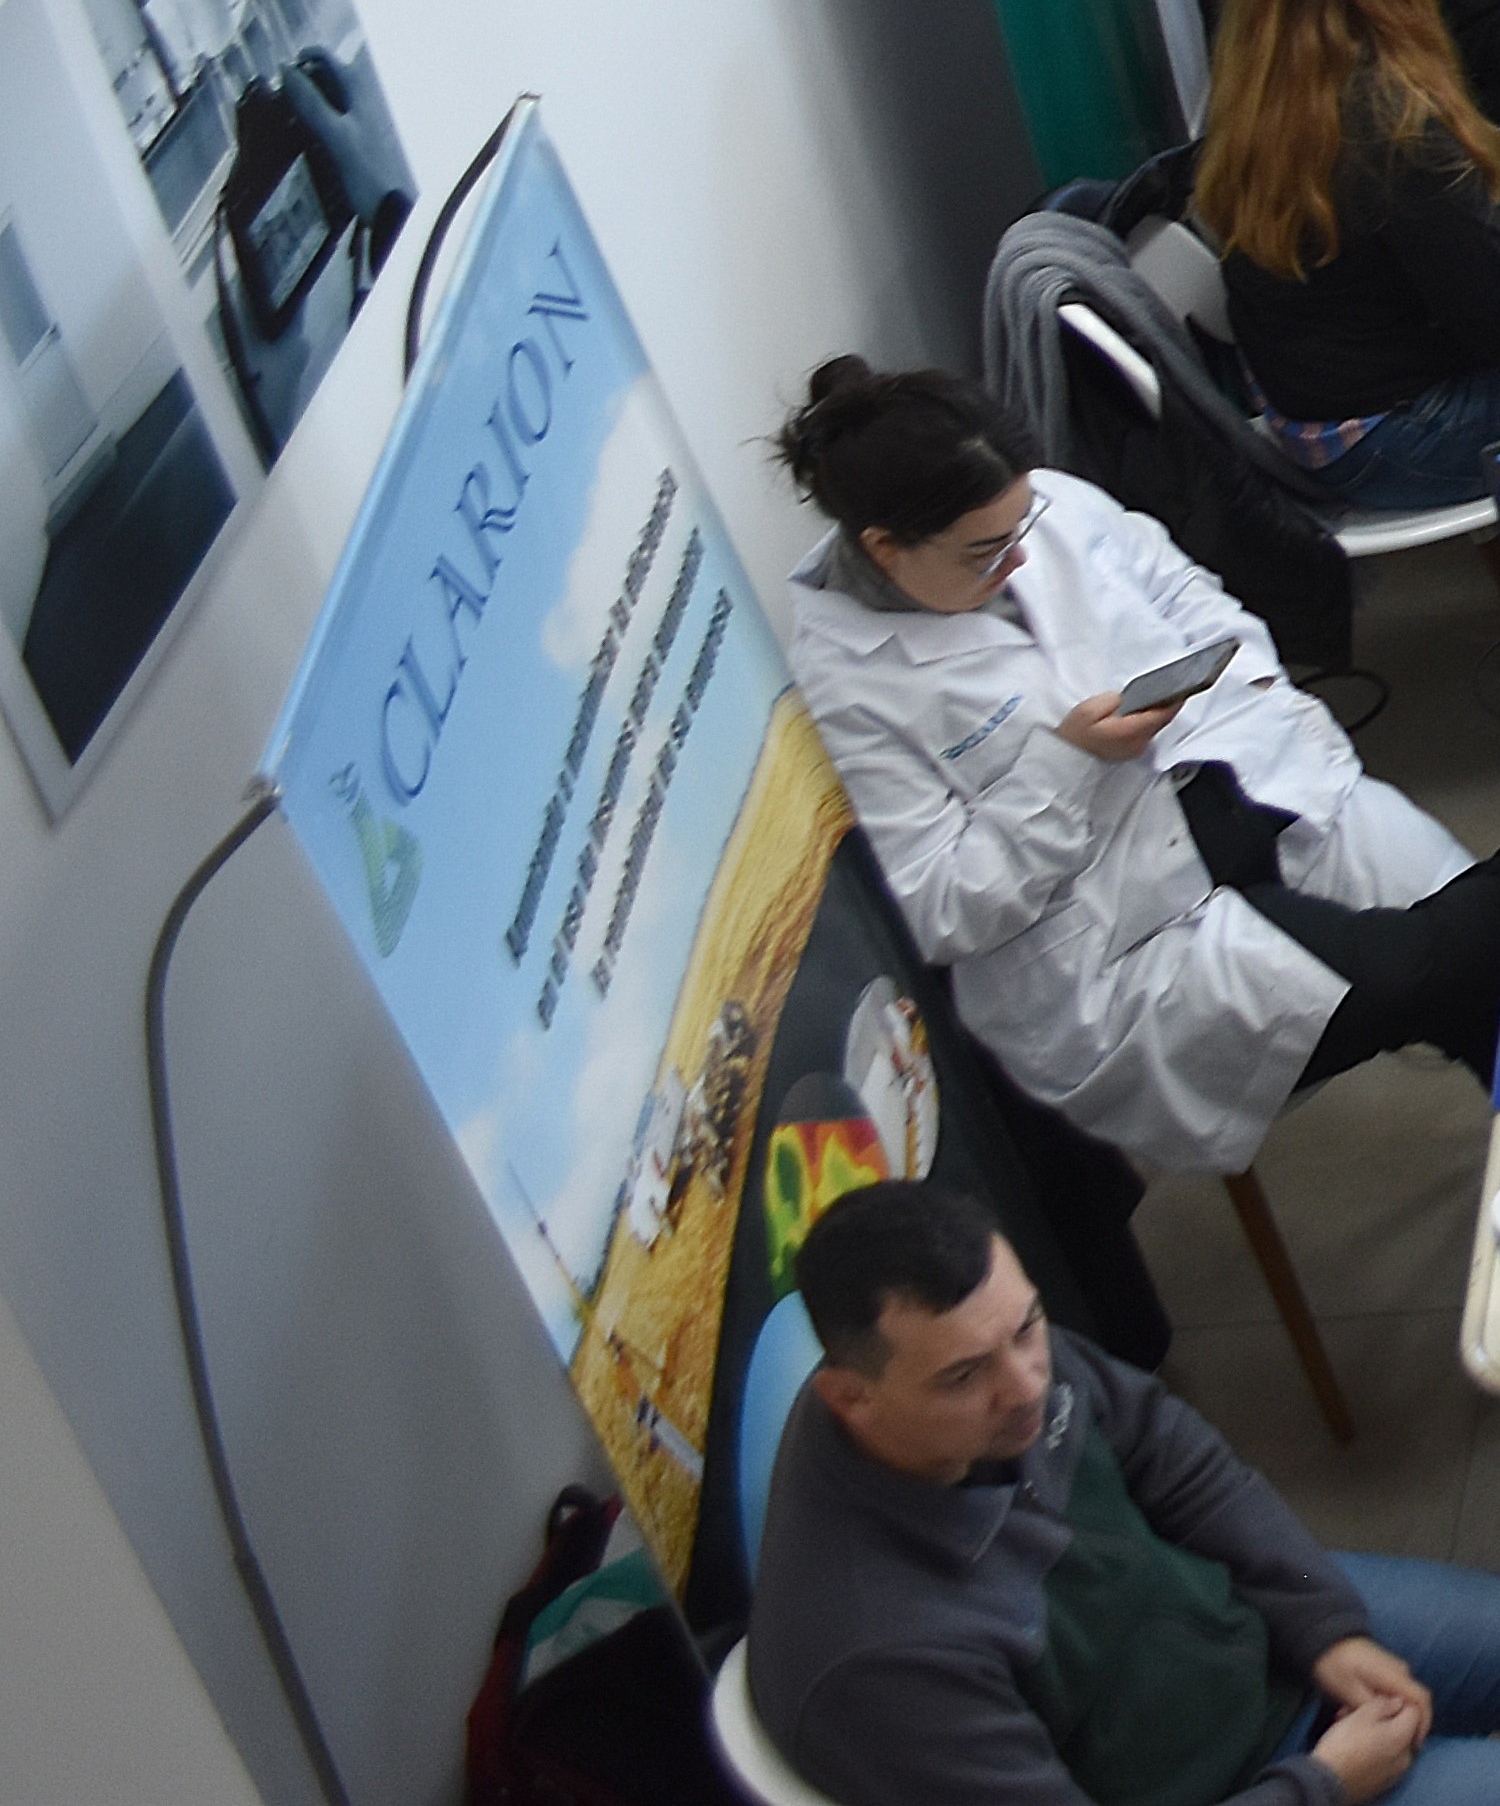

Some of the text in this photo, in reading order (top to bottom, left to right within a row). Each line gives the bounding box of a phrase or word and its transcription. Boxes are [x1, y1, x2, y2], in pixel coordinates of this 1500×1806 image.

[378, 235, 591, 807] CLARION
[620, 457, 679, 608] eficiencia
[587, 715, 637, 854] insumos
[627, 651, 662, 730] para
[651, 522, 706, 666] aumentar
[666, 698, 691, 753] su
[682, 582, 734, 717] empresa
